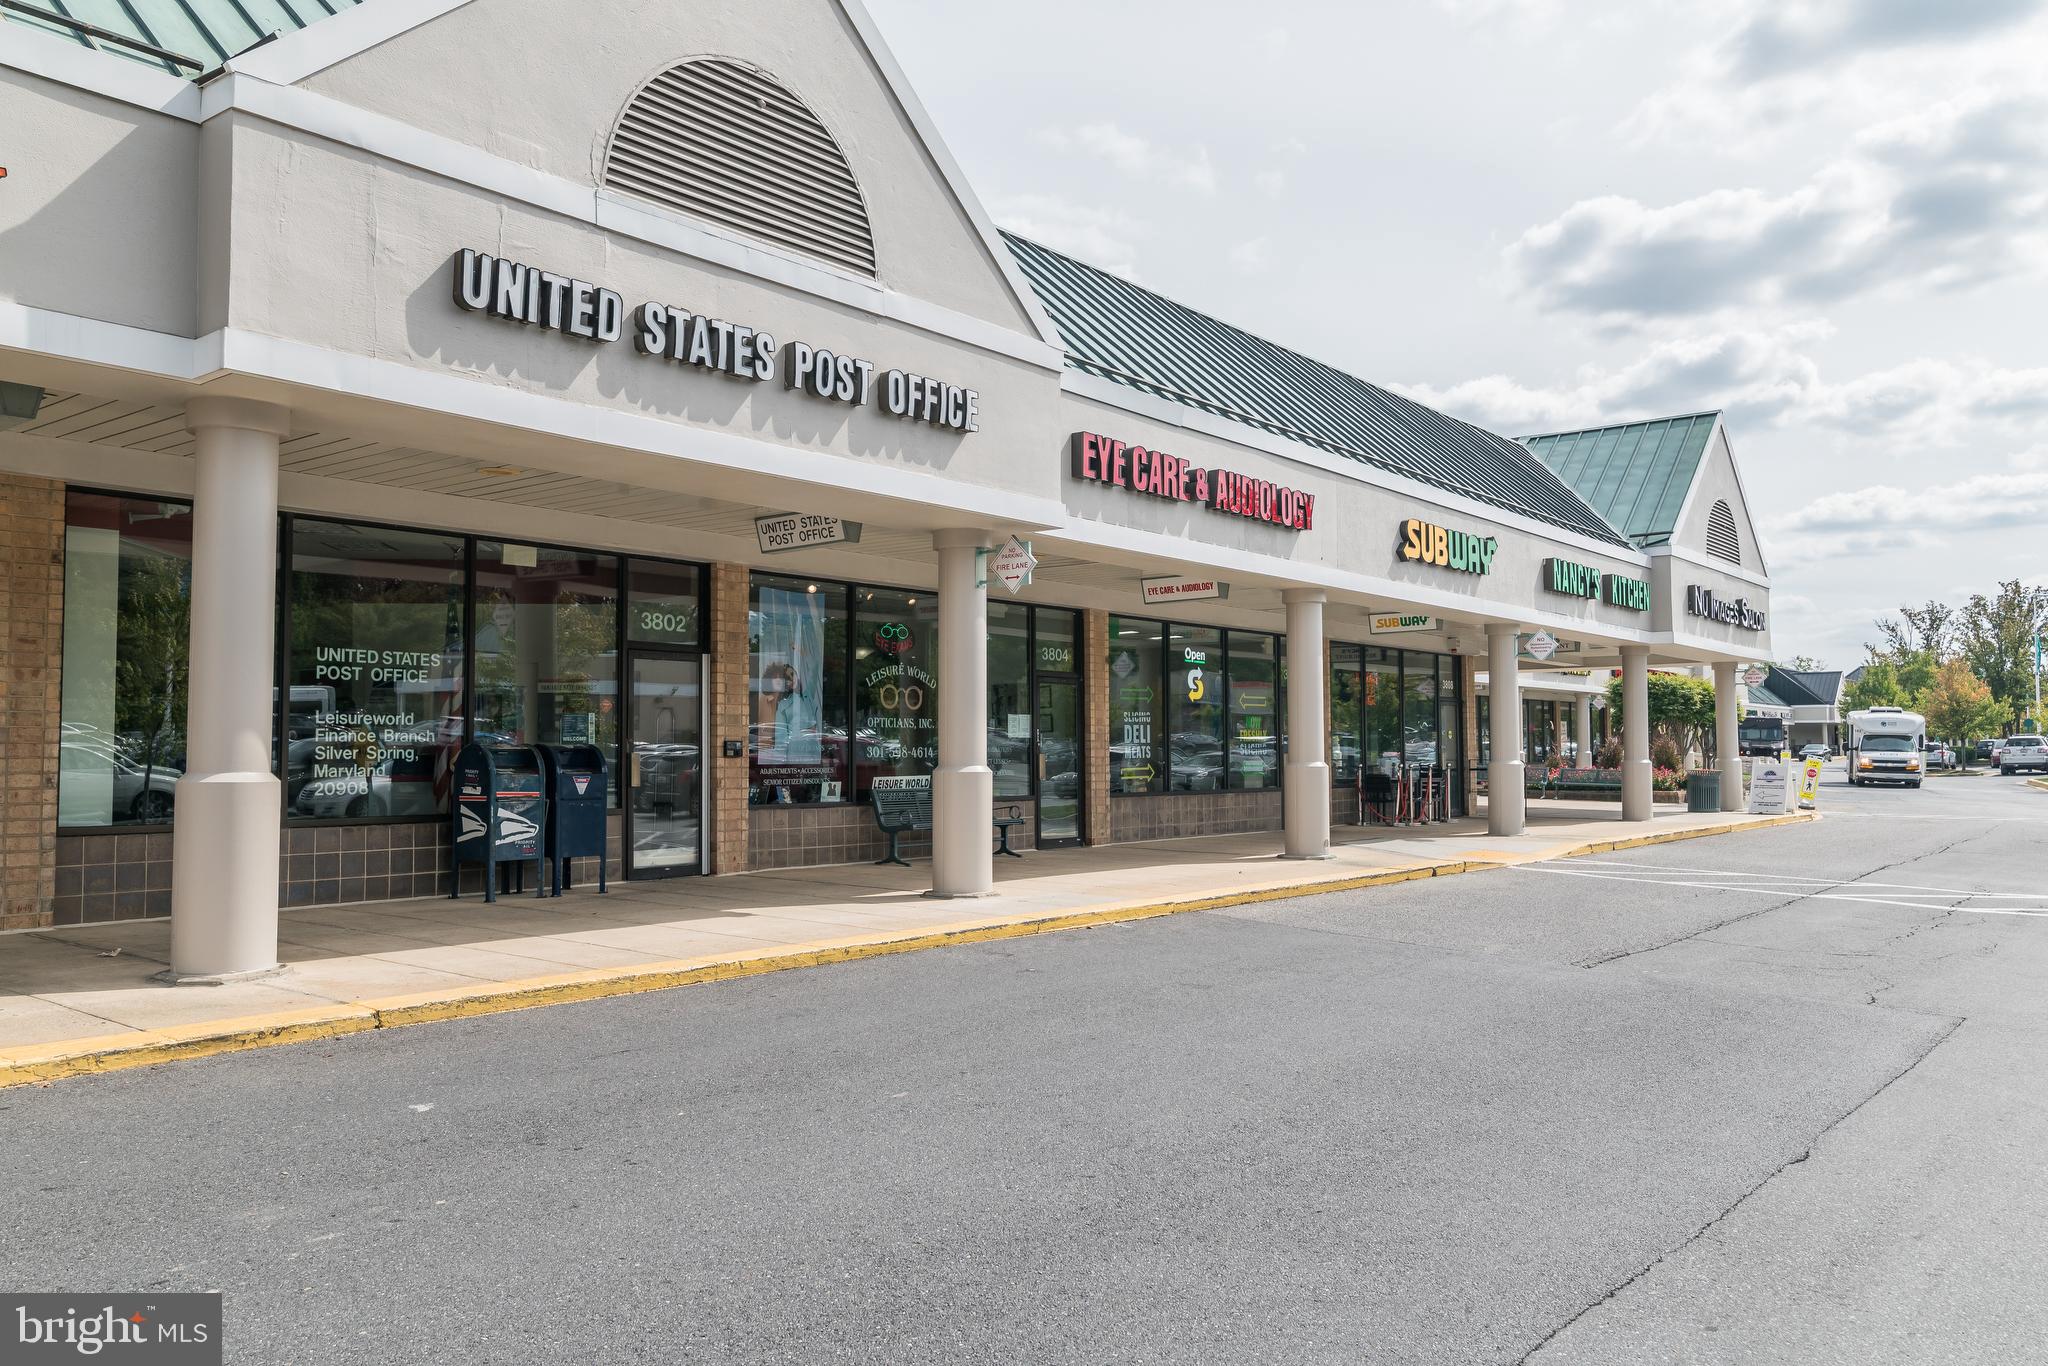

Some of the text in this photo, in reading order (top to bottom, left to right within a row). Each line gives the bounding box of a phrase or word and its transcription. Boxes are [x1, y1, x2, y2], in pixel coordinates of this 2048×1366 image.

[455, 248, 979, 433] UNITED STATES POST OFFICE
[1074, 431, 1315, 530] EYE CARE & AUDIOLOGY
[761, 519, 796, 535] UNITED
[769, 526, 836, 546] POST OFFICE
[1398, 518, 1498, 575] SUBWAY
[1012, 562, 1029, 570] LANE
[1148, 587, 1159, 596] EYE
[1160, 585, 1175, 594] CARE
[1182, 582, 1214, 593] AUDIOLOGY
[1547, 558, 1650, 611] NANCY'S KITCHEN
[641, 611, 687, 632] 3802
[1376, 616, 1430, 629] SUBWAY
[1710, 598, 1739, 625] IMAGES
[1740, 598, 1766, 631] SALON
[316, 646, 441, 667] UNITED STATES
[1041, 647, 1069, 661] 3804
[1184, 647, 1206, 661] Open
[316, 665, 429, 683] POST OFFICE
[865, 664, 937, 688] LEISURE WORLD
[315, 710, 414, 725] Leisureworld
[867, 717, 935, 730] OPTICIANS, INC.
[1123, 711, 1151, 722] SLICING
[315, 728, 435, 743] Finance Branch
[1124, 724, 1151, 744] DELI
[314, 746, 419, 763] Silver Spring,
[866, 746, 934, 759] 301-598-4614
[1124, 746, 1151, 759] MEATS
[314, 764, 386, 780] Maryland
[314, 781, 369, 796] 20908
[873, 778, 930, 789] LEISURE WORLD
